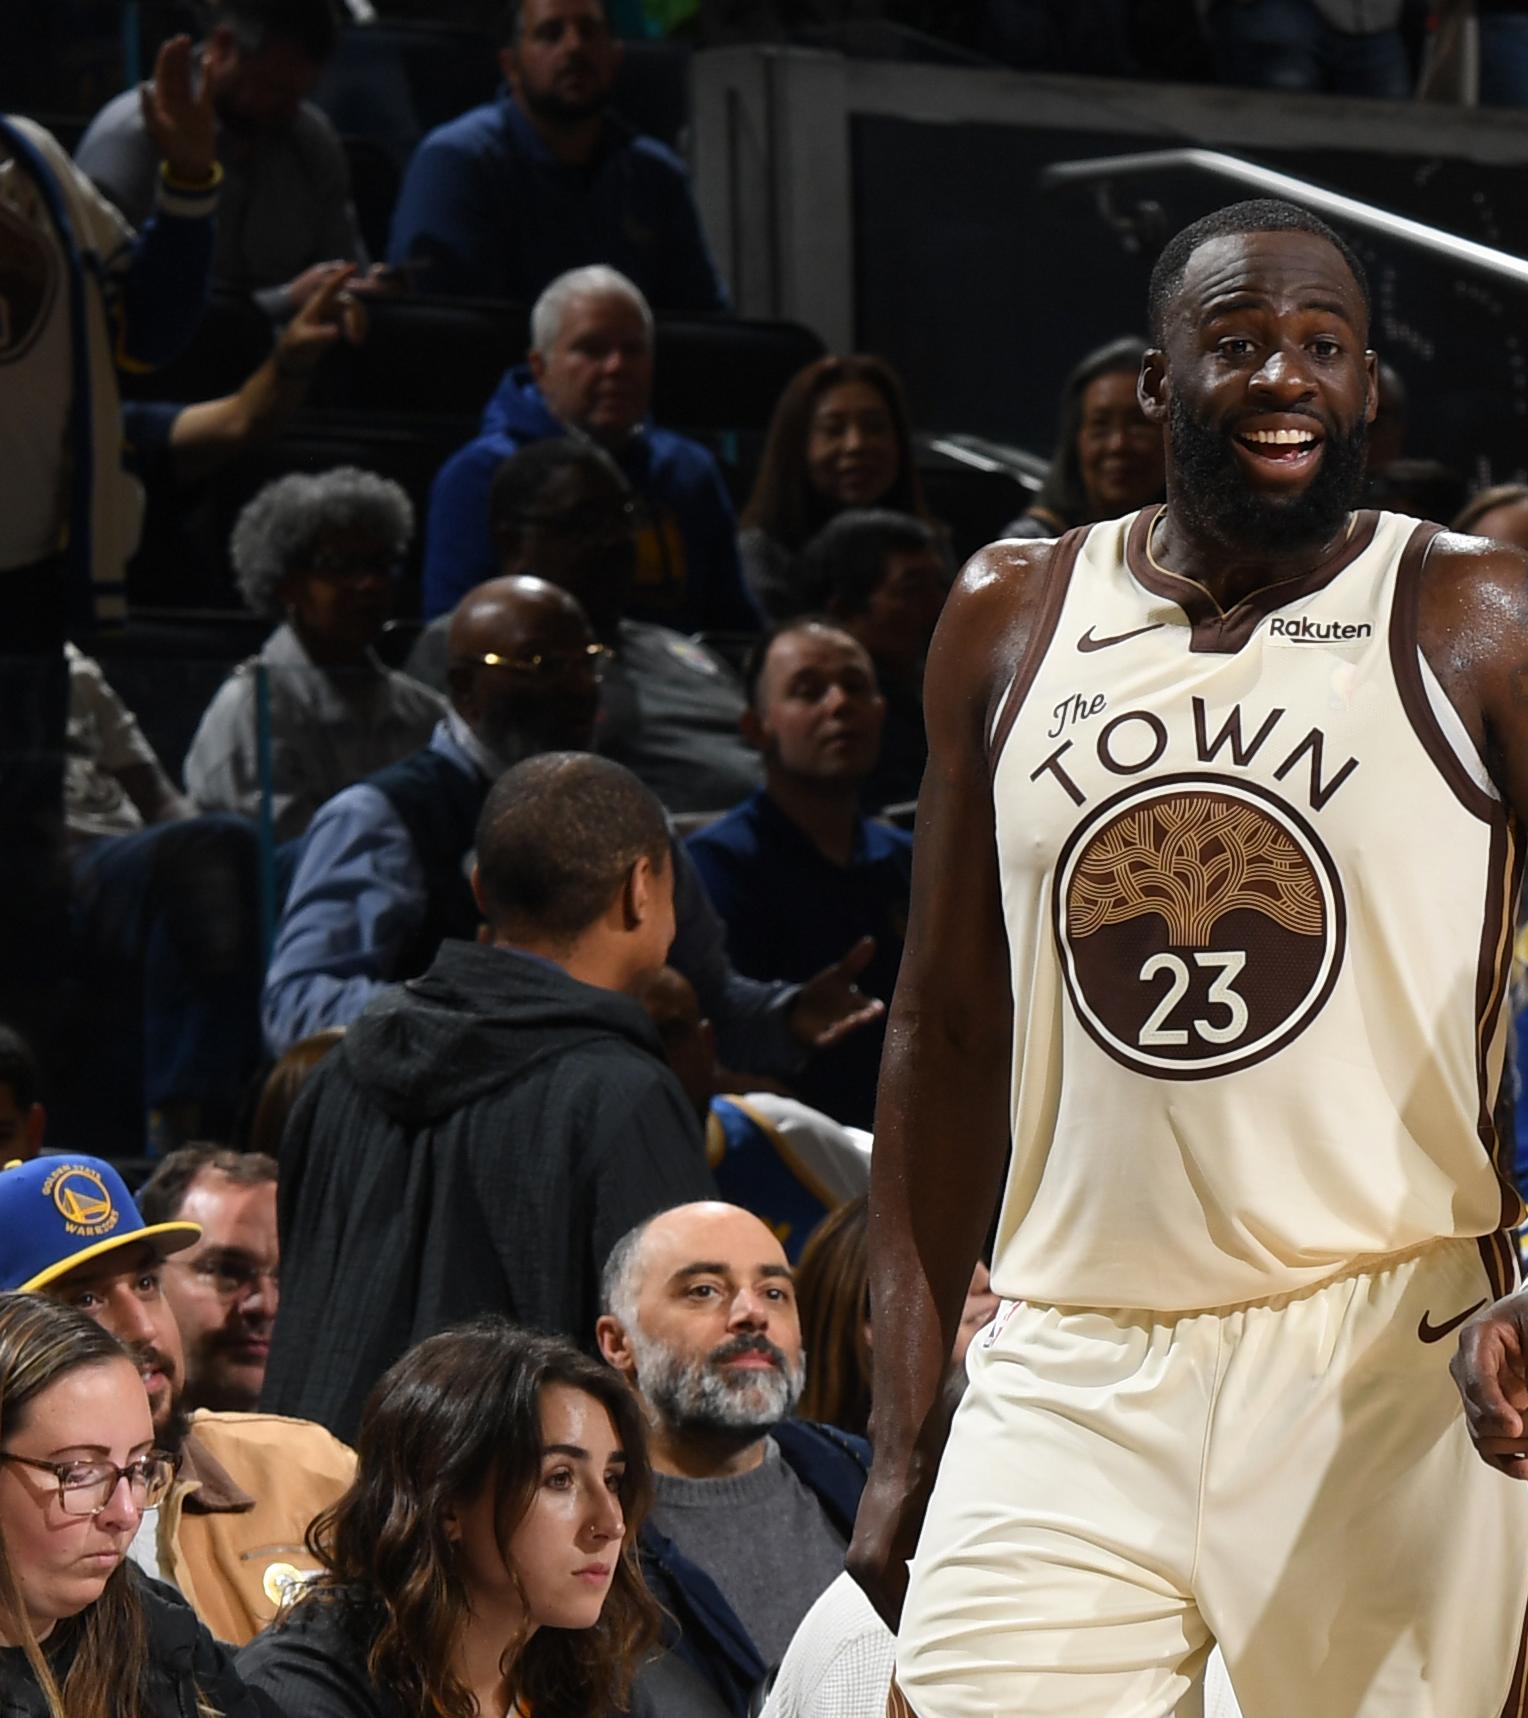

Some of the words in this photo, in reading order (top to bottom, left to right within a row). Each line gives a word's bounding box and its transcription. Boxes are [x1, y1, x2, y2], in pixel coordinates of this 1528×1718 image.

[1269, 616, 1372, 643] Rakuten
[1047, 692, 1107, 739] The
[1029, 695, 1360, 812] TOWN
[1138, 950, 1249, 1047] 23
[42, 1164, 72, 1195] GOLDEN
[64, 1207, 119, 1236] WARRIORS
